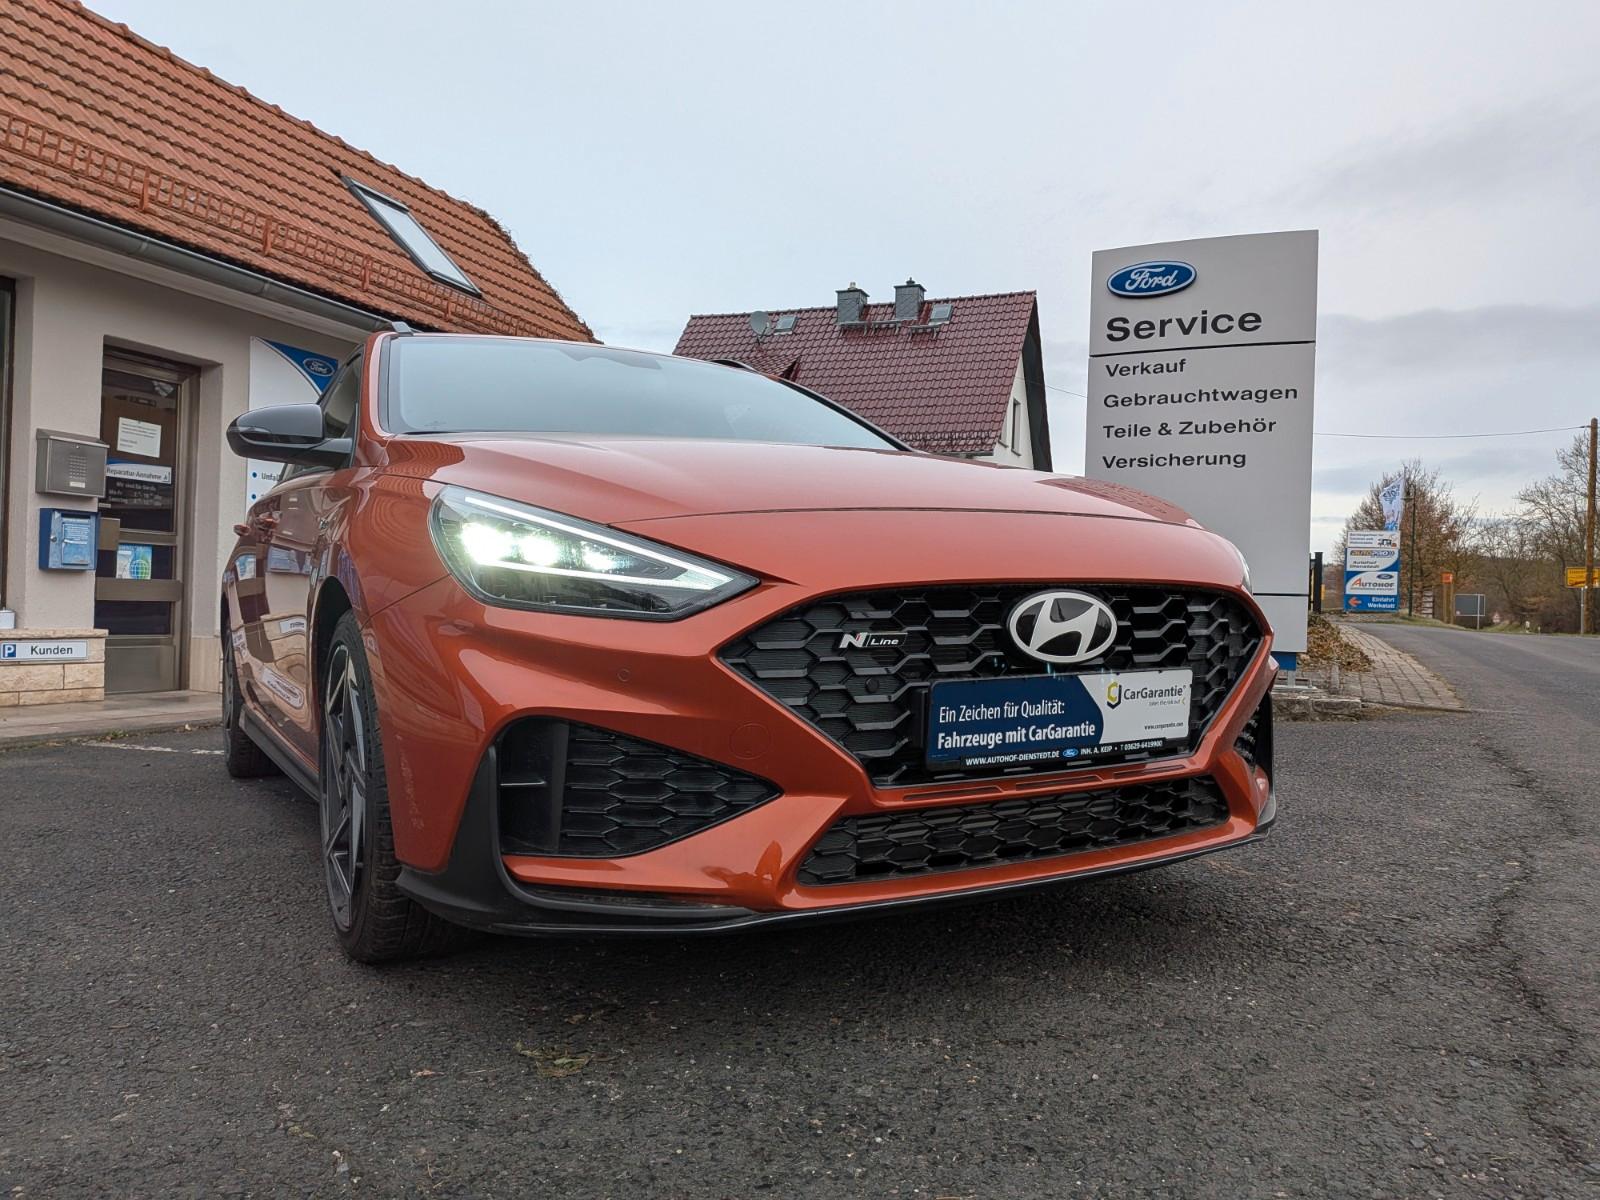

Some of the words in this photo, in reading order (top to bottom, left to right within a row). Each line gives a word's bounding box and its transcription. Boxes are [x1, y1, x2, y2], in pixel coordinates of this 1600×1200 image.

[1125, 266, 1179, 291] Ford
[1106, 310, 1262, 342] Service
[1105, 358, 1187, 378] Verkauf
[1103, 388, 1298, 408] Gebrauchtwagen
[1103, 423, 1152, 439] Teile
[1158, 422, 1173, 436] &
[1179, 418, 1277, 435] Zubehör
[1102, 453, 1247, 469] Versicherung
[106, 467, 162, 480] Reparatur-Annahme
[4, 645, 15, 657] P
[30, 645, 73, 655] Kunden
[939, 706, 956, 723] Ein
[958, 704, 1001, 722] Zeichen
[1003, 702, 1020, 718] für
[1021, 699, 1065, 718] Qualität:
[937, 731, 1003, 749] Fahrzeuge
[1005, 726, 1027, 744] mit
[1028, 721, 1096, 741] CarGarantie
[965, 750, 1060, 766] WWW.AUTOHOF-DIENSTEDT.DE
